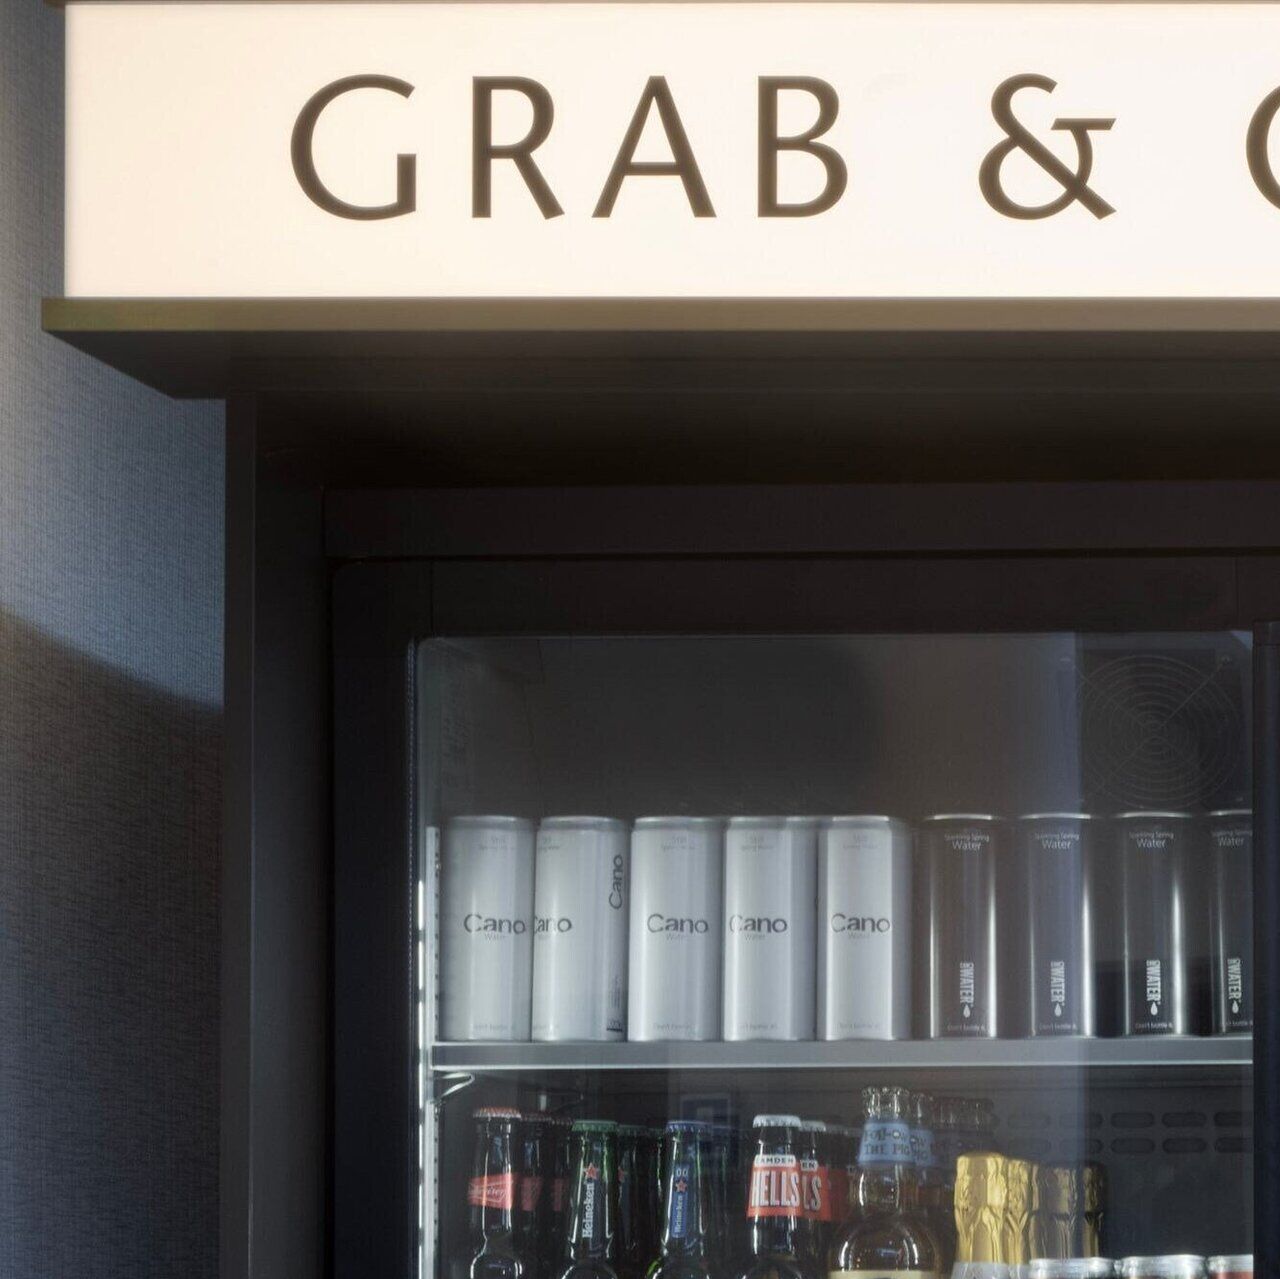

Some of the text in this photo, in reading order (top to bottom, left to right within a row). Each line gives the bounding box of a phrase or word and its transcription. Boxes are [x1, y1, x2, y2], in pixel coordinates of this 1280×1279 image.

[289, 73, 850, 221] GRAB
[977, 73, 1118, 221] &
[952, 839, 982, 851] Water
[1042, 838, 1071, 850] Water
[1137, 838, 1166, 849] Water
[1218, 836, 1245, 847] Water
[609, 854, 624, 910] Cano
[463, 913, 526, 935] Cano
[647, 913, 709, 934] Cano
[729, 914, 788, 934] Cano
[831, 913, 891, 934] Cano
[751, 1171, 800, 1208] HELLS
[583, 1182, 595, 1238] Heineken
